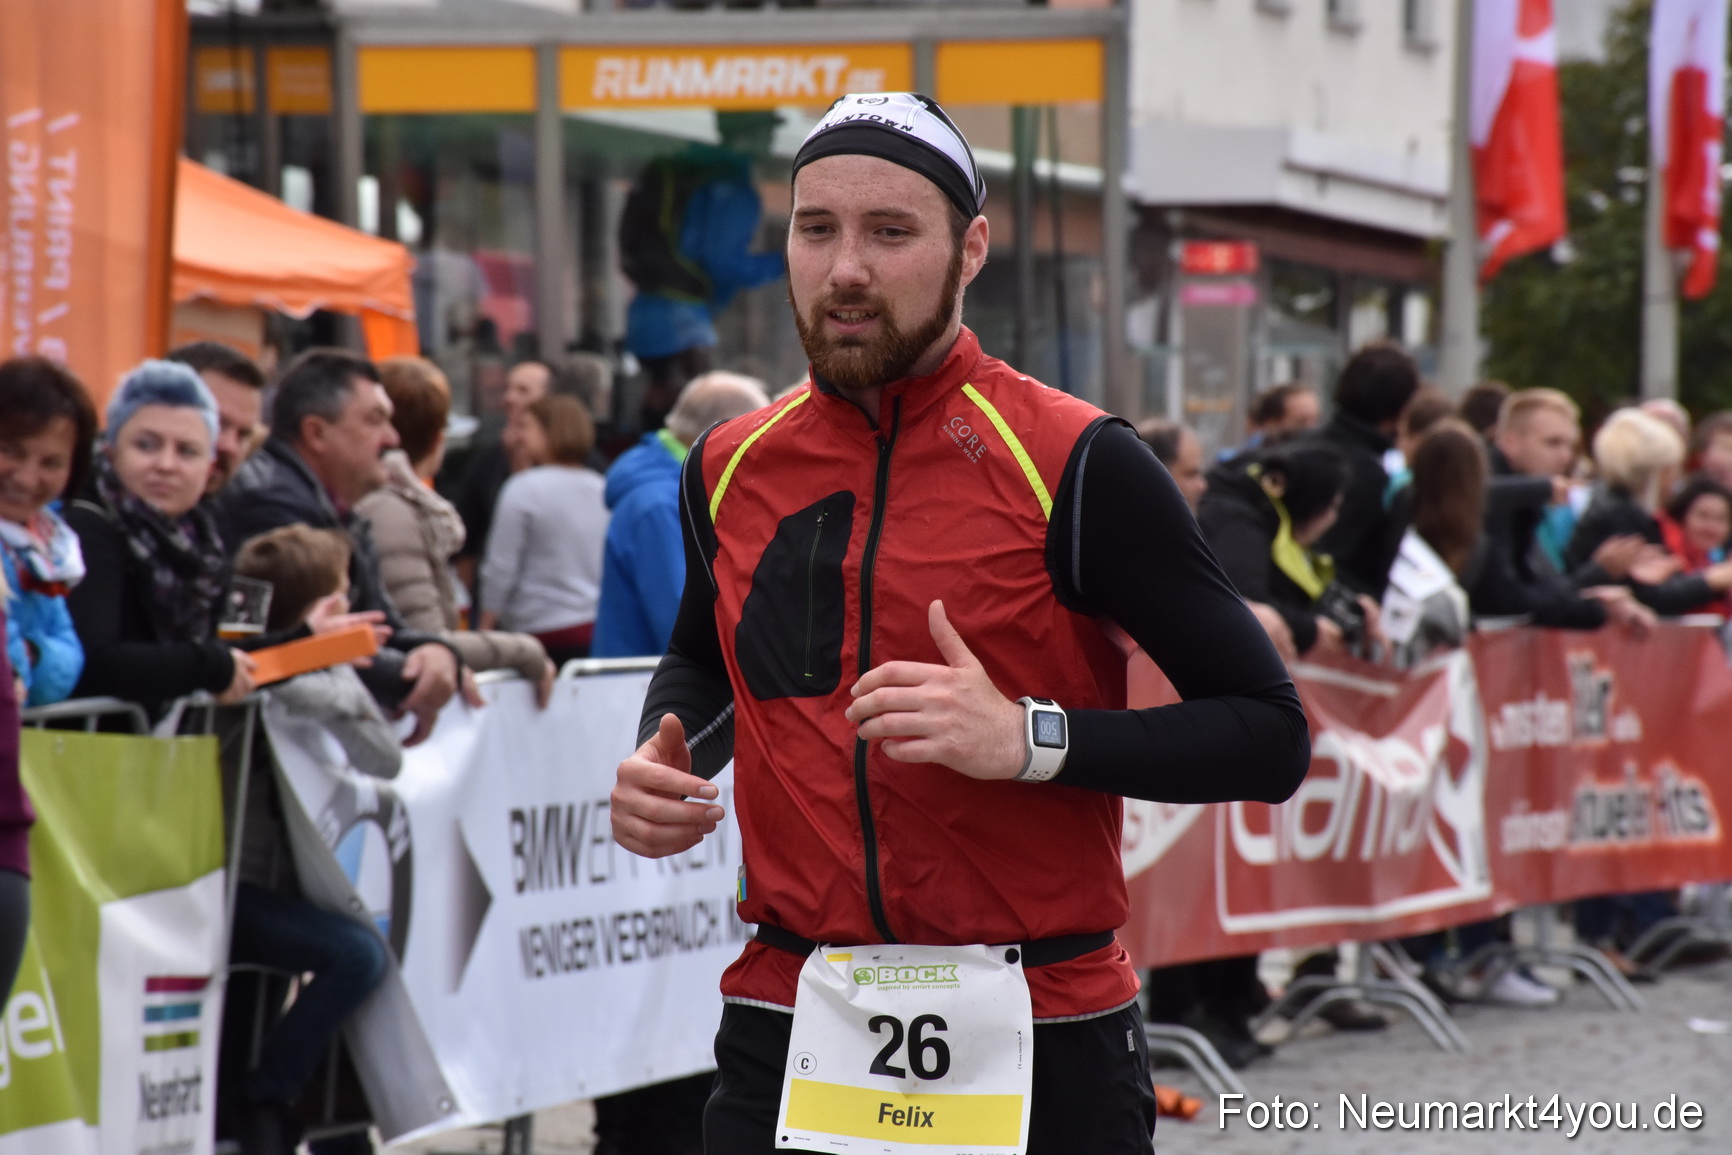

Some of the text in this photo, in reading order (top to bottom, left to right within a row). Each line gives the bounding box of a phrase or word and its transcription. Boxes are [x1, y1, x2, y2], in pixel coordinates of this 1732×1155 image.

[942, 424, 978, 464] RUNNING WEAR
[950, 416, 987, 459] GORE
[877, 964, 960, 985] BOCK
[877, 984, 901, 992] inspired
[868, 1013, 951, 1081] 26
[800, 1057, 809, 1070] C
[878, 1102, 935, 1128] Felix
